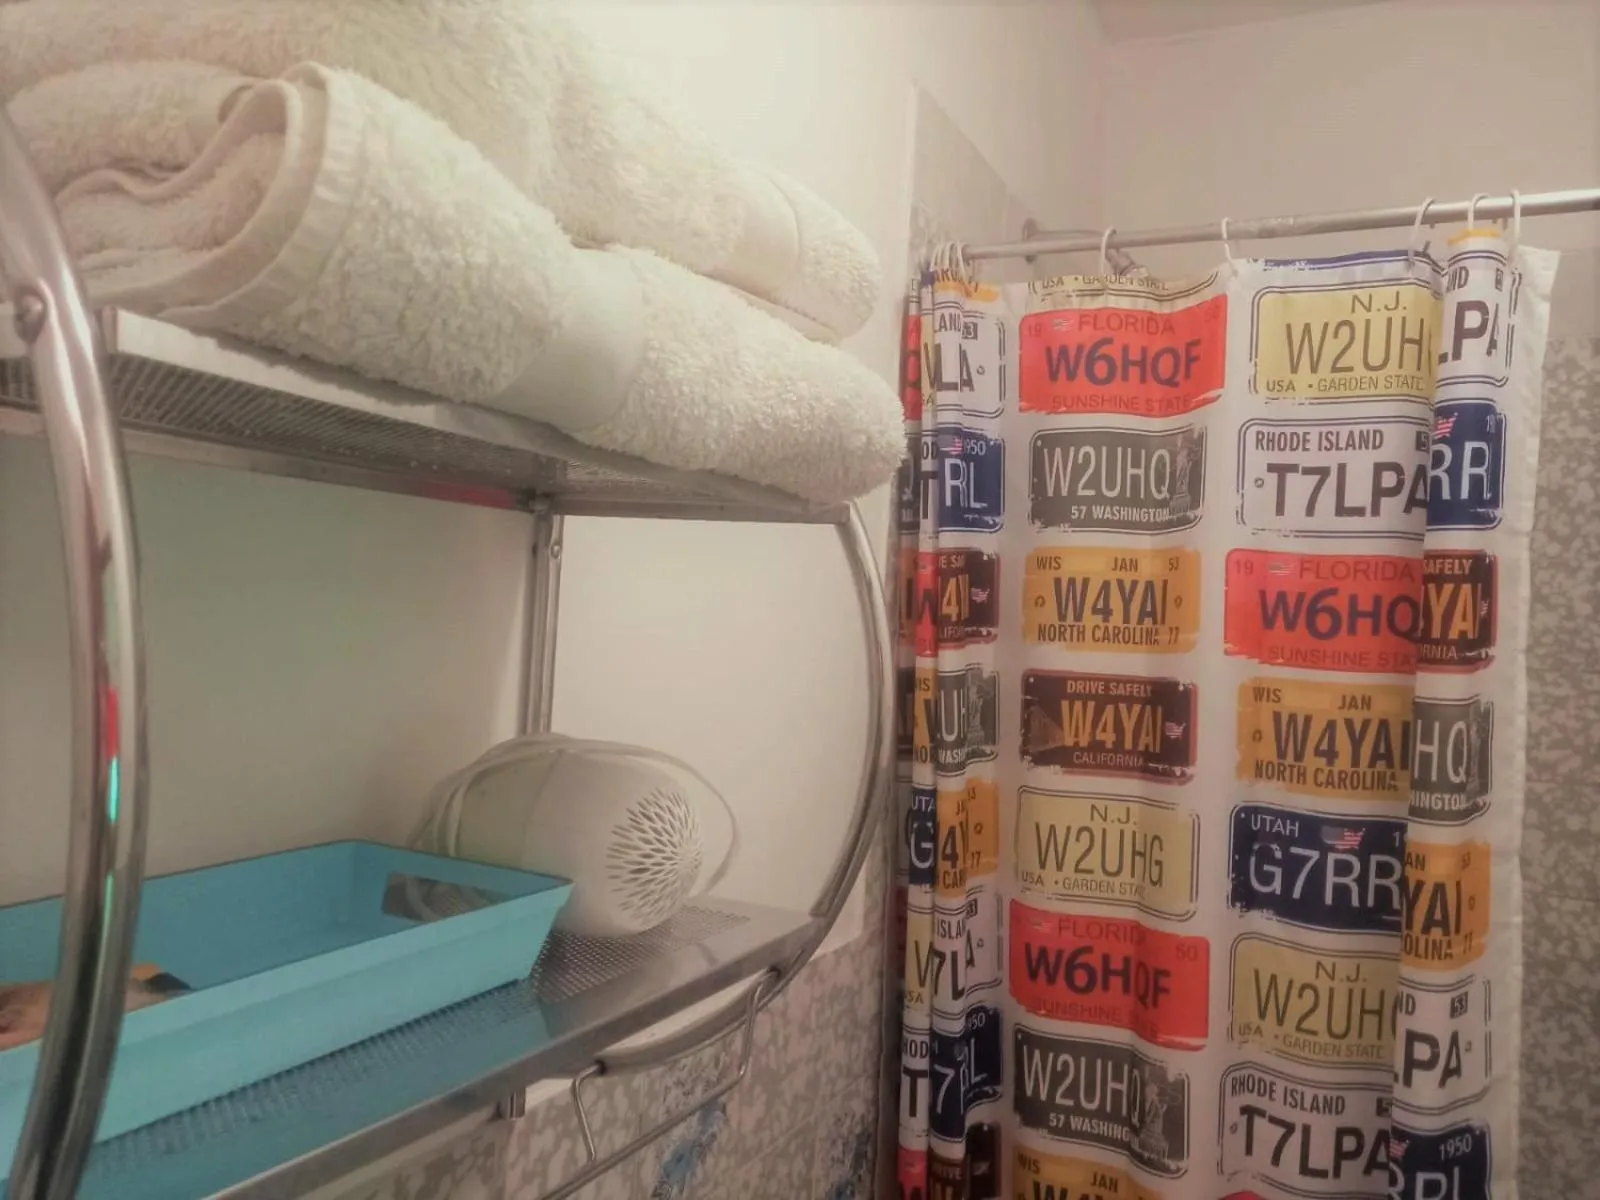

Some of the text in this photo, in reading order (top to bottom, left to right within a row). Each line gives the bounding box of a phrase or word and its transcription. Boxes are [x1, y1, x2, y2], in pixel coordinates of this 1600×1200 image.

[1350, 291, 1407, 314] N.J.
[1078, 312, 1176, 336] FLORIDA
[1286, 317, 1431, 374] W2UH
[1045, 337, 1201, 388] W6HQF
[1266, 375, 1424, 393] USA GARDEN STATE
[1052, 393, 1193, 412] SUNSHINE STATE
[1255, 429, 1384, 452] RHODE ISLAND
[1043, 445, 1171, 500] W2UHQ
[1267, 461, 1427, 518] T7LPA
[1071, 505, 1171, 523] 57 WASHINGTON
[1036, 556, 1062, 571] WIS
[1112, 557, 1139, 573] JAN
[1235, 560, 1415, 582] 19 FLORIDA
[1053, 576, 1168, 626] W4YAI
[1037, 623, 1085, 643] NORTH
[1091, 625, 1160, 647] CAROLINA
[1267, 645, 1368, 666] SUNSHINE
[1066, 679, 1153, 697] DRIVE SAFELY
[1252, 686, 1372, 712] WIS JAN
[1060, 699, 1163, 754] W4YAI
[1072, 751, 1144, 767] CALIFORNIA
[1254, 759, 1399, 792] NORTH CAROLINA
[1089, 803, 1138, 826] N.J.
[1251, 814, 1299, 838] UTAH
[1034, 821, 1165, 889] W2UHG
[1021, 870, 1044, 887] USA
[1062, 876, 1116, 895] GARDEN
[1025, 942, 1171, 1009] W6HQF
[1315, 960, 1367, 983] N.J.
[1254, 968, 1397, 1041] W2UH
[1238, 1022, 1263, 1038] USA
[1282, 1033, 1342, 1057] GARDEN
[1023, 1045, 1142, 1129] W2UHQ
[1230, 1073, 1276, 1101] RHODE
[1283, 1085, 1346, 1116] ISLAND
[1050, 1112, 1065, 1129] 57
[1239, 1104, 1391, 1180] T7LPA
[1439, 1133, 1473, 1161] 1950
[1017, 1151, 1041, 1175] WIS
[1090, 1171, 1119, 1193] JAN
